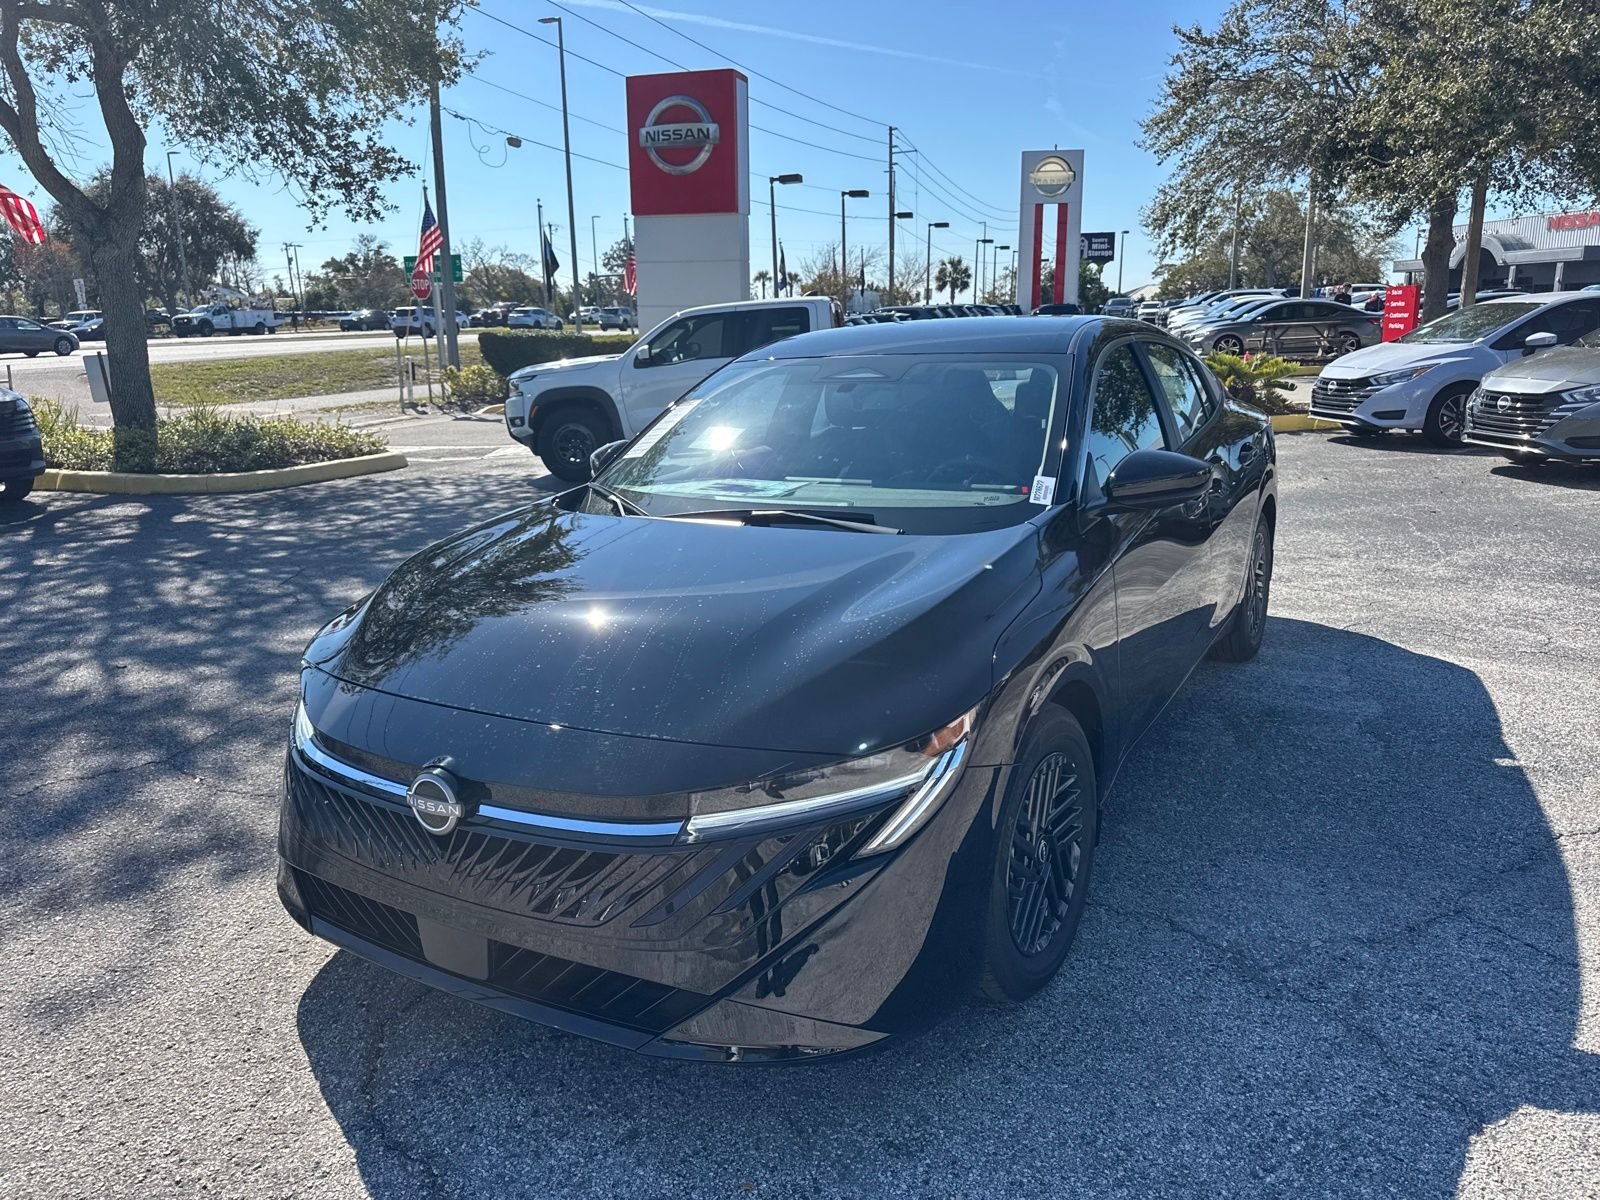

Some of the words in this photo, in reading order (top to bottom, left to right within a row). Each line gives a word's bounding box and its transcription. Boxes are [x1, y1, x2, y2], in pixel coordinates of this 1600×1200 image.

[645, 128, 710, 143] NISSAN
[1548, 211, 1600, 231] NISSA
[412, 279, 430, 290] STOP
[406, 794, 459, 815] NISSAN
